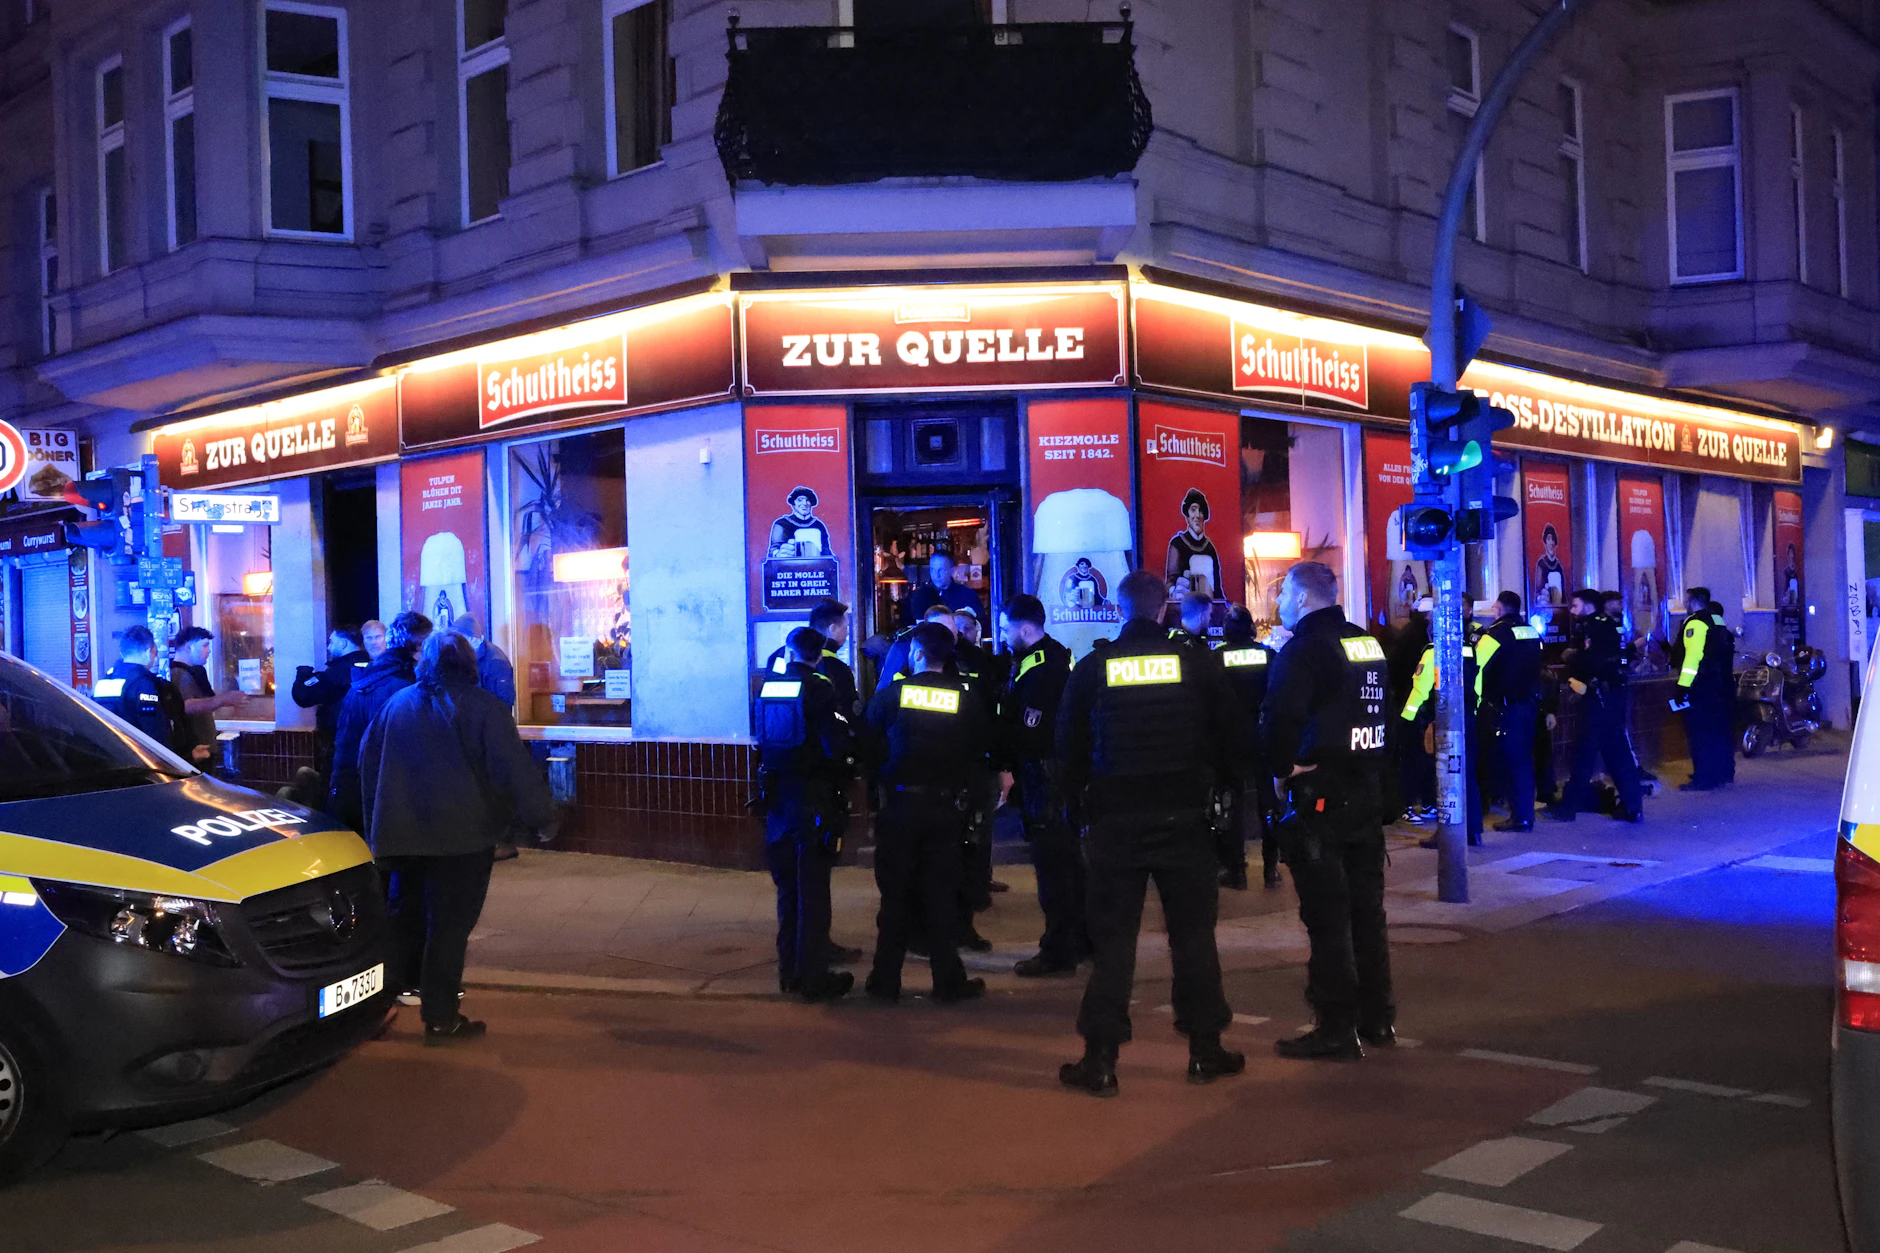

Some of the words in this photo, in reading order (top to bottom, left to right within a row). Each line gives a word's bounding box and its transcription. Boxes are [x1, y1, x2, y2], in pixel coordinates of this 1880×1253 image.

[782, 333, 881, 367] ZUR
[896, 327, 1084, 367] QUELLE
[1241, 334, 1360, 393] Schultheiss
[487, 352, 617, 411] Schultheiss
[29, 432, 68, 447] BIG
[206, 437, 247, 470] ZUR
[251, 418, 335, 463] QUELLE
[761, 433, 834, 449] Schultheiss
[1039, 434, 1119, 446] KIEZMOLLE
[1160, 432, 1221, 459] Schultheiss
[1697, 428, 1730, 460] ZUR
[1733, 434, 1787, 467] QUELLE
[1045, 450, 1075, 460] SEIT
[1081, 449, 1114, 459] 1842.
[428, 475, 455, 486] TULPEN
[422, 487, 449, 498] BLÜHEN
[1529, 483, 1563, 500] Schultheiss
[421, 500, 443, 512] JANZE
[23, 532, 56, 548] Currywurst
[794, 571, 824, 579] MOLLE
[800, 580, 830, 588] GREIF-
[771, 589, 801, 597] BARER
[803, 588, 831, 596] NÄHE.
[1052, 607, 1118, 622] Schultheiss
[1224, 650, 1267, 667] POLIZEI
[1108, 658, 1178, 683] POLIZEI
[1366, 671, 1378, 685] BE
[903, 688, 957, 711] POLIZEI
[1360, 686, 1384, 700] 12110
[170, 808, 308, 846] POLIZEI
[336, 985, 343, 1007] B
[352, 969, 376, 1001] 7330
